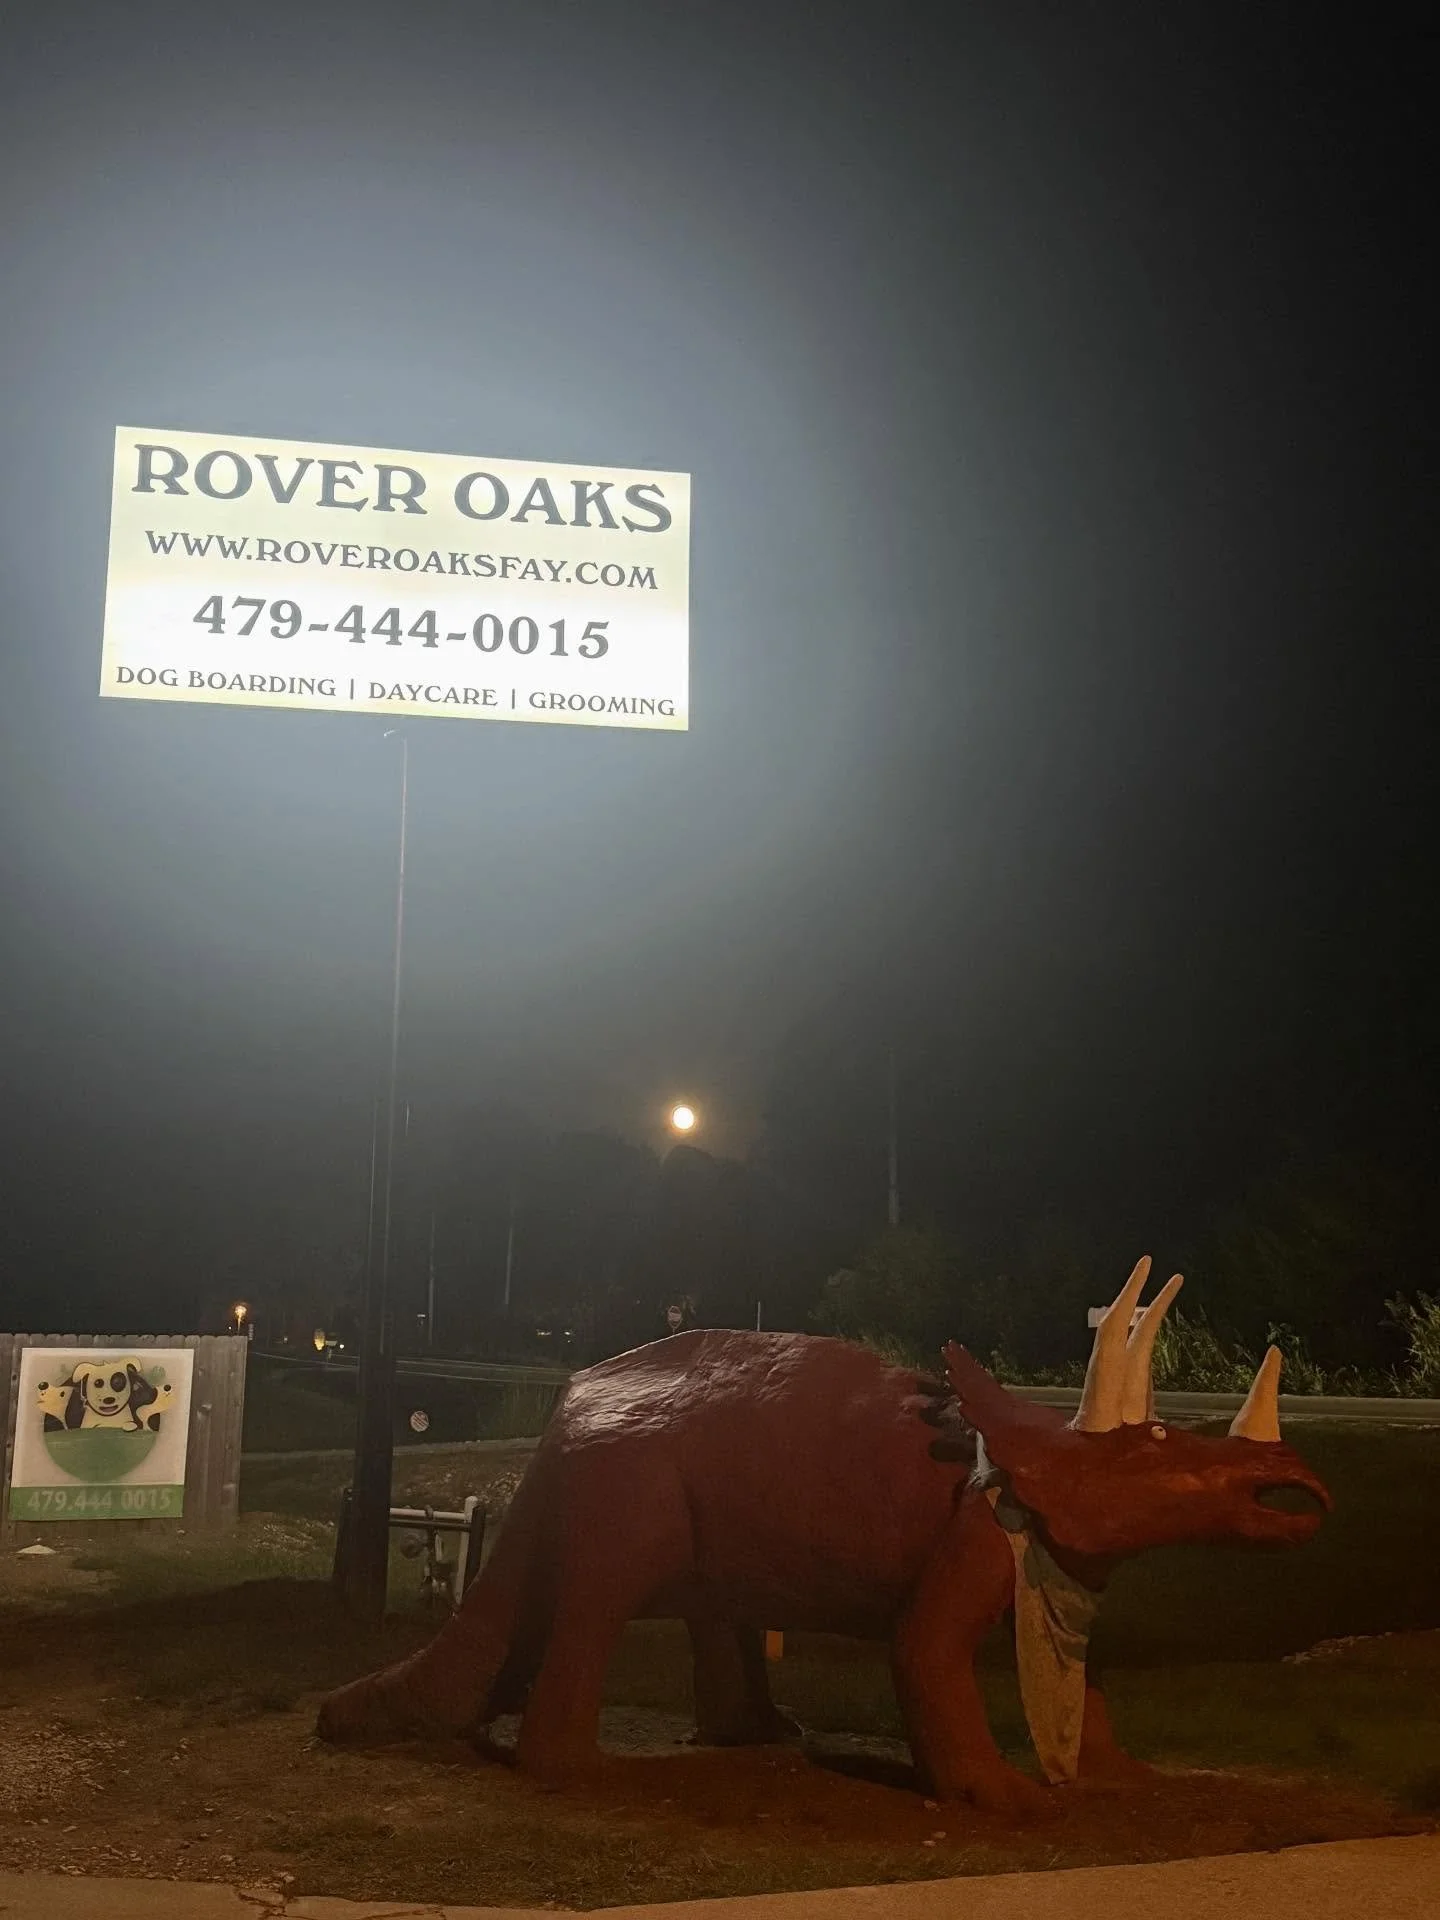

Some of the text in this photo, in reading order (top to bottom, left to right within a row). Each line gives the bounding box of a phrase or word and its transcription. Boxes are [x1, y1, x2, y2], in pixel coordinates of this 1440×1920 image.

[131, 444, 672, 533] ROVER OAKS
[144, 530, 658, 590] WWW.ROVEROAKSFAY.COM
[193, 595, 610, 659] 479-444-0015
[116, 666, 178, 687] DOG
[188, 670, 336, 697] BOARDING
[369, 682, 498, 706] DAYCARE
[529, 692, 675, 716] GROOMING
